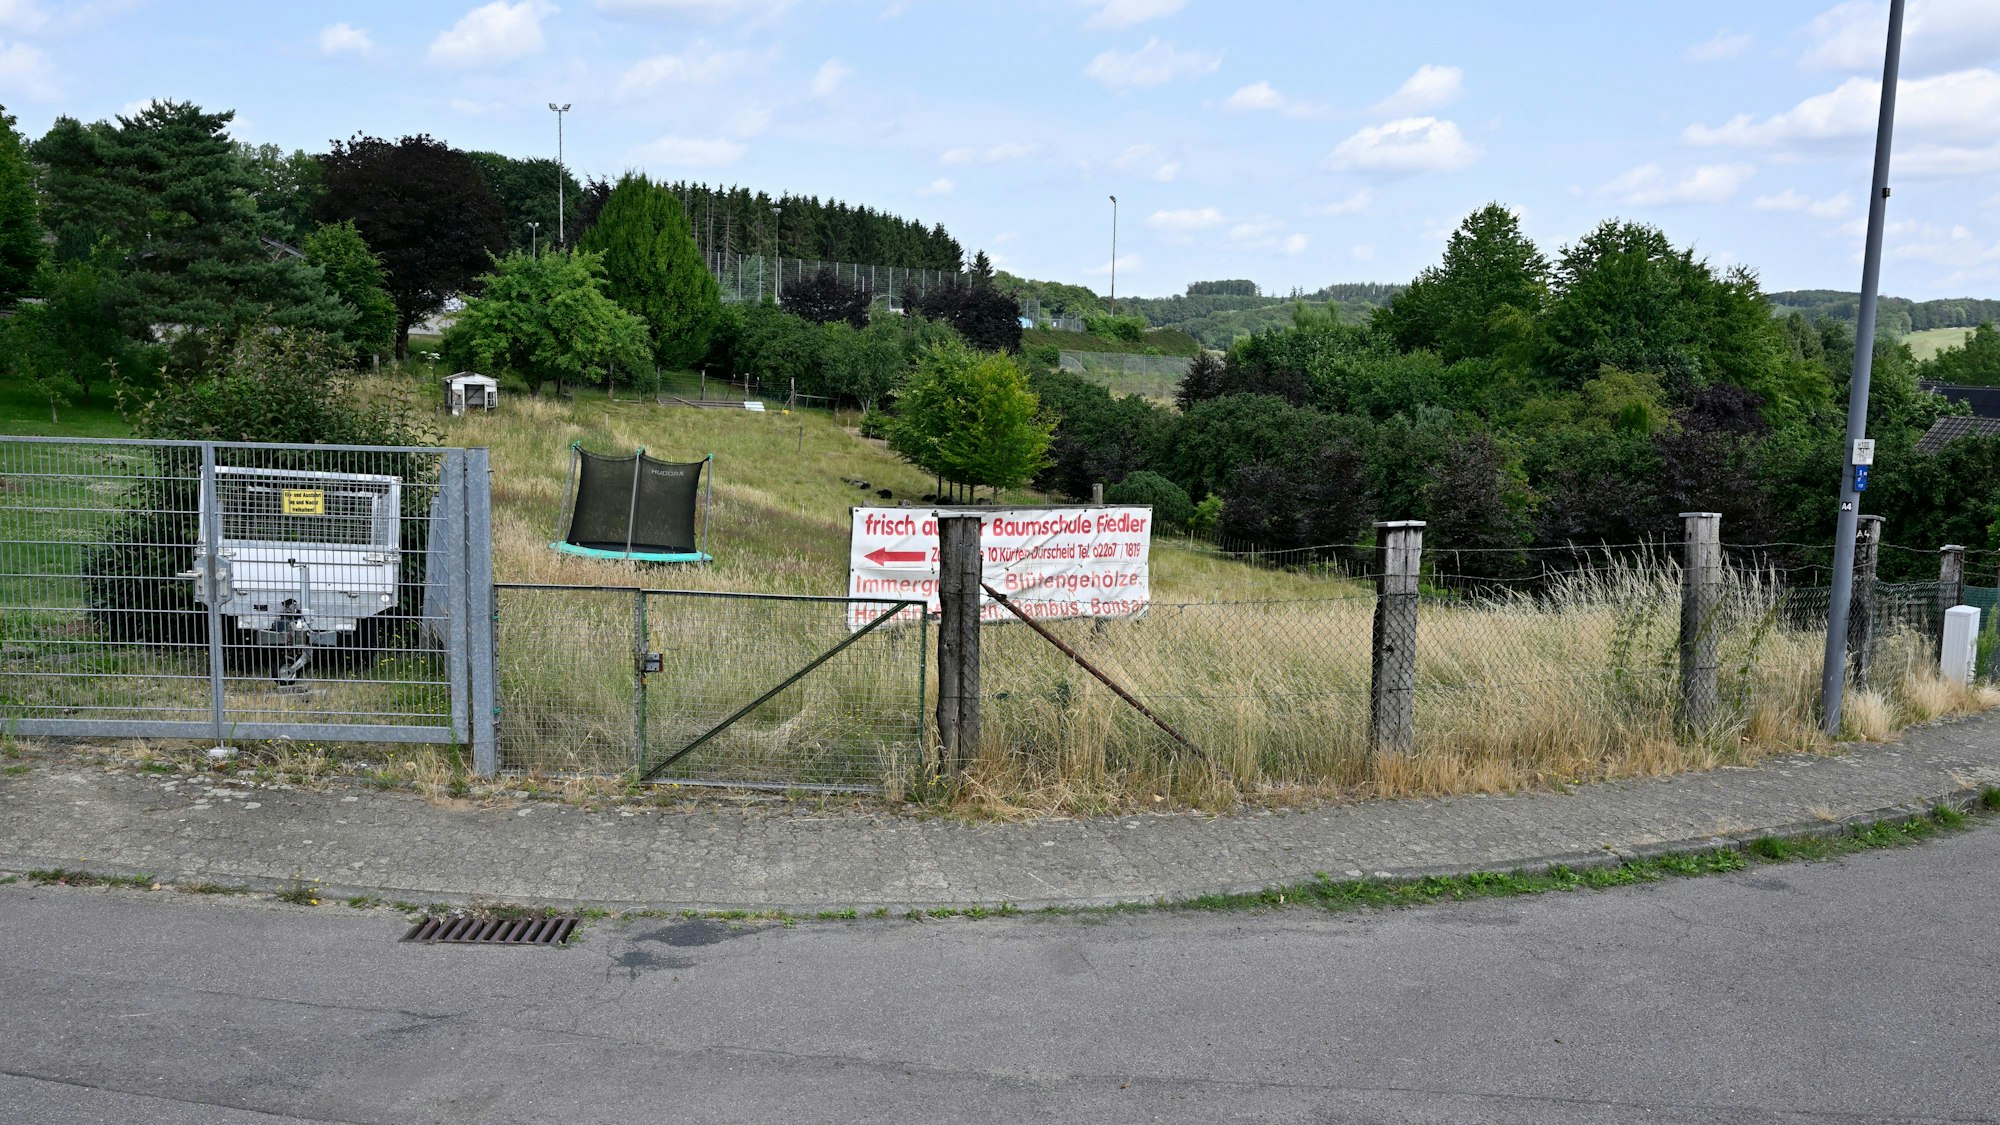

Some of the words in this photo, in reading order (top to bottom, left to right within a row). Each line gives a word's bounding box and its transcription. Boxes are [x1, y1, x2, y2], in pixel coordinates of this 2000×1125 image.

[865, 513, 916, 536] frisch
[993, 514, 1092, 537] Baumschule
[1096, 513, 1147, 533] Fiedler
[987, 547, 998, 562] 10
[1078, 543, 1090, 559] Tel.
[1124, 542, 1141, 558] 1819
[1090, 595, 1144, 616] Bonsai
